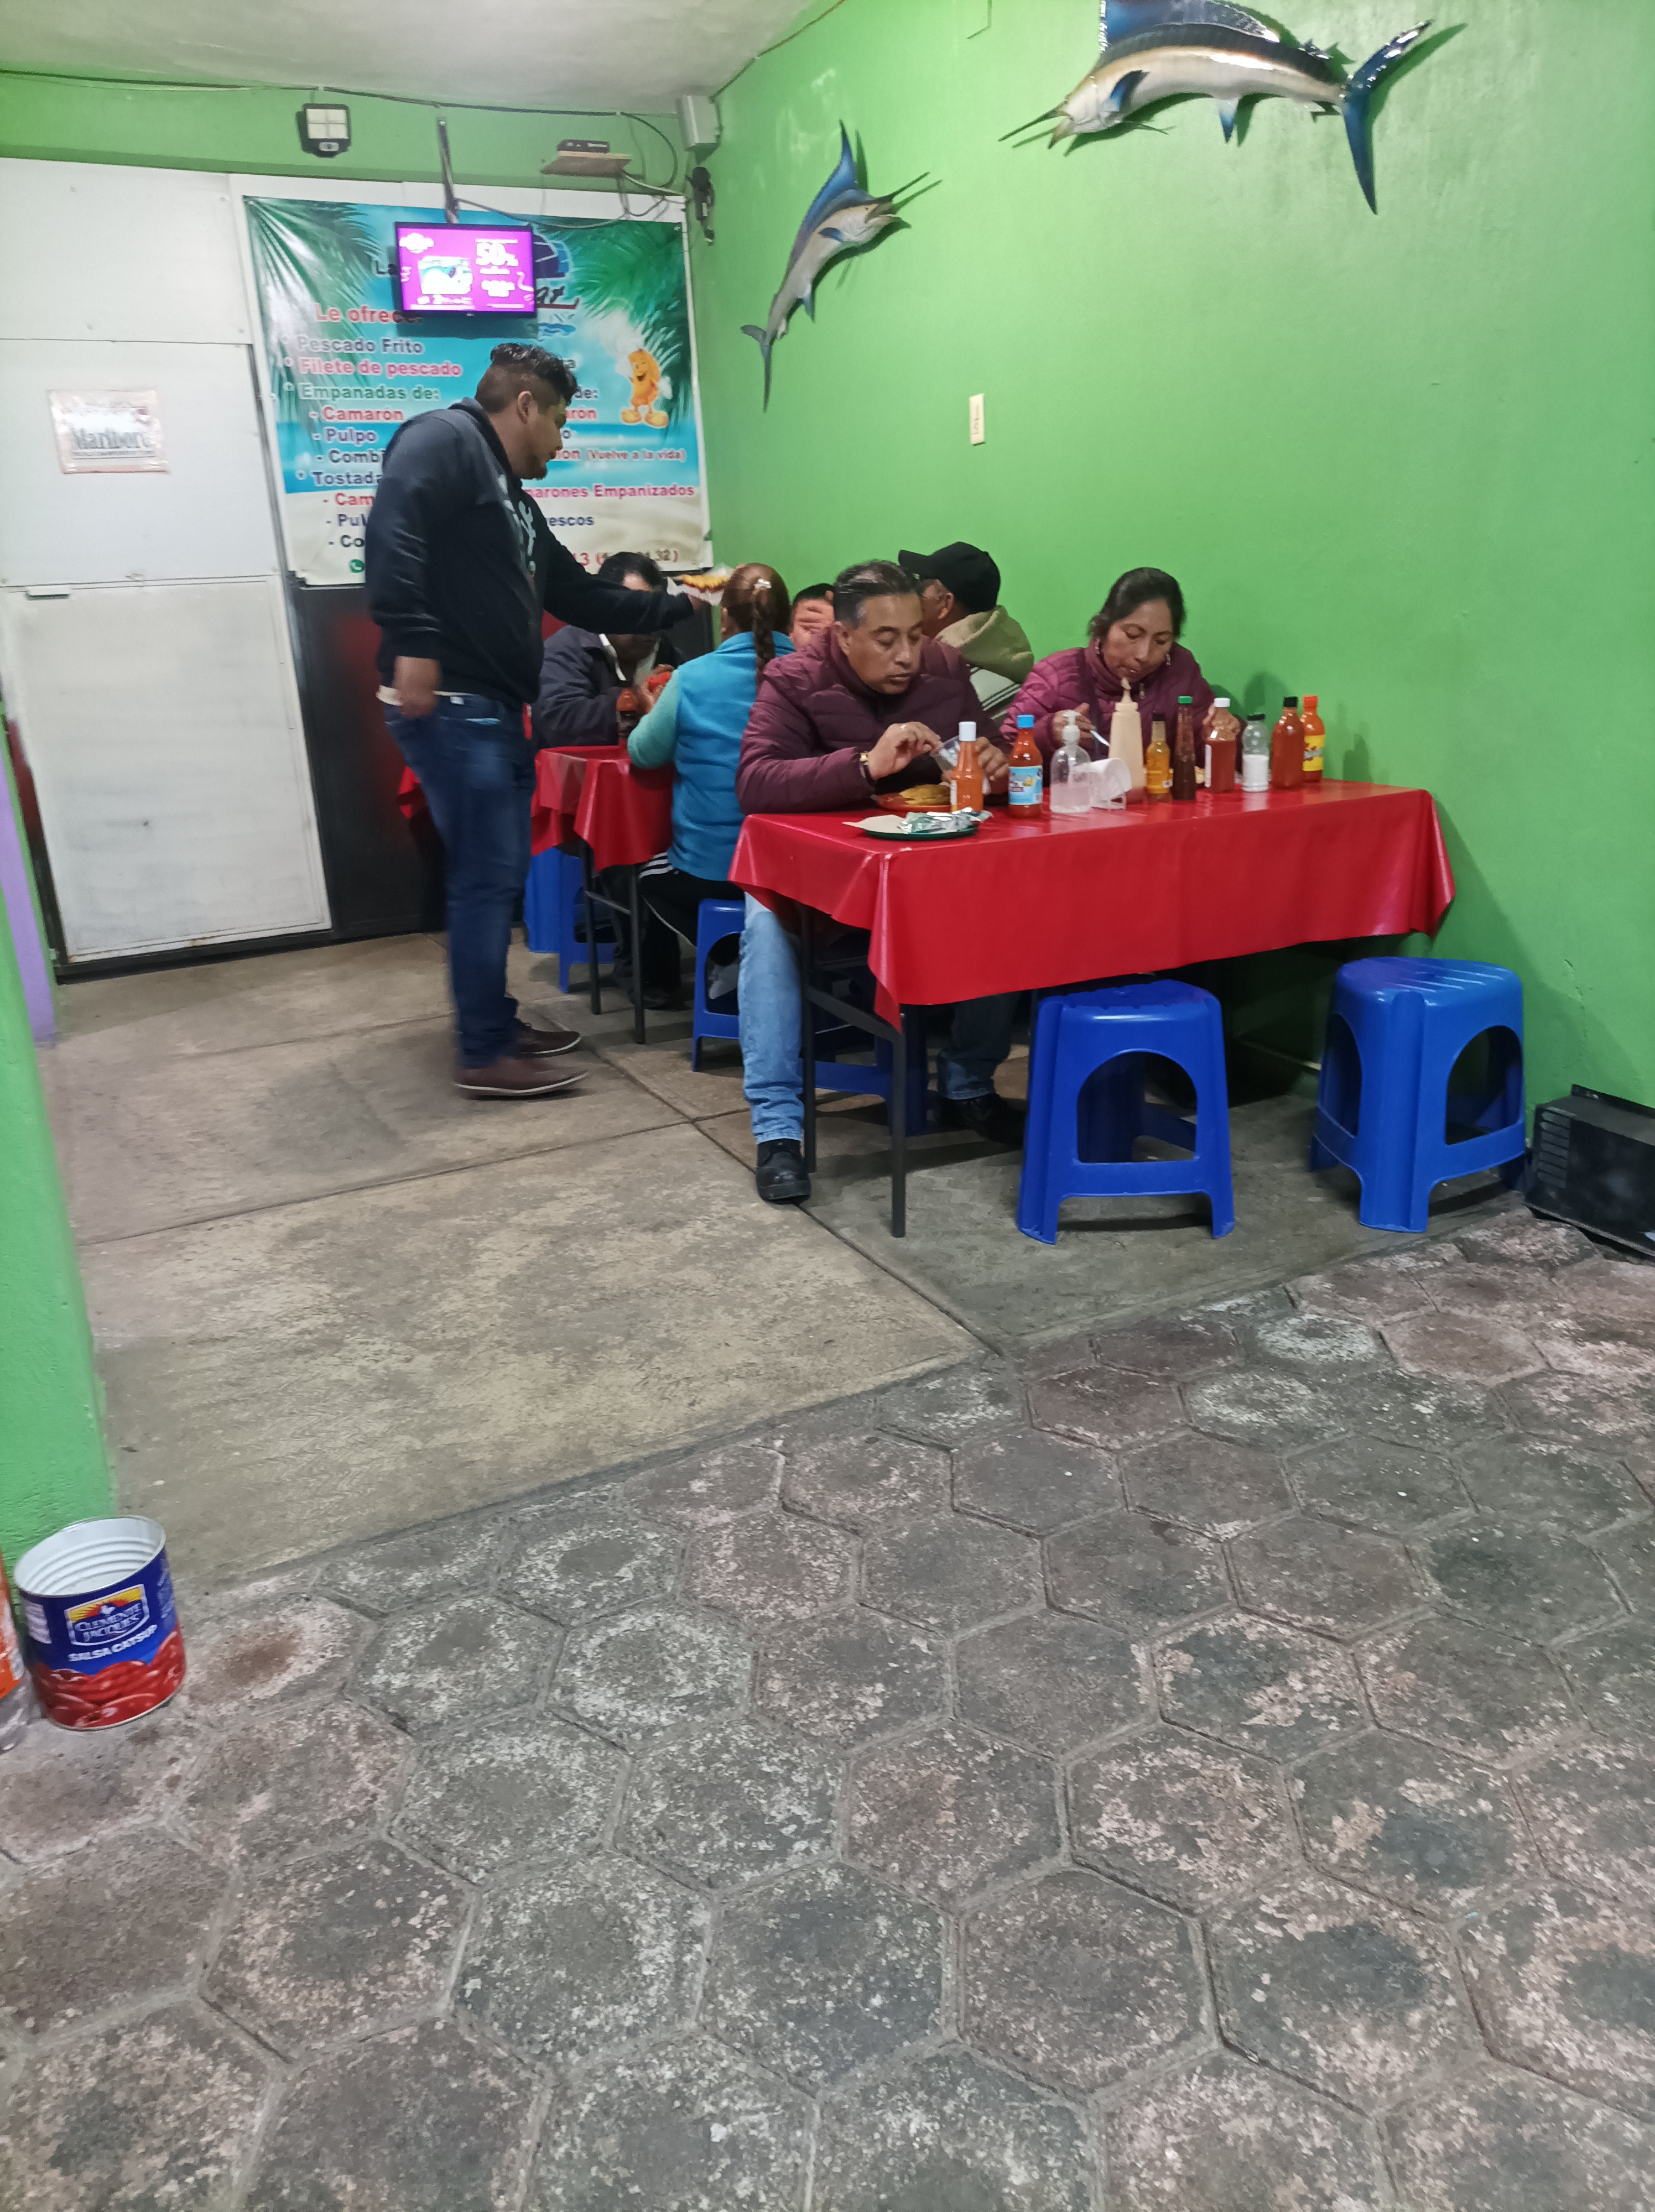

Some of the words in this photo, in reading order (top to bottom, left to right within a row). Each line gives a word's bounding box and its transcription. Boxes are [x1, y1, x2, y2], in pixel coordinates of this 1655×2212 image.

[315, 304, 342, 322] Le
[298, 336, 376, 353] Pescado
[382, 338, 424, 354] Frito
[300, 358, 354, 374] Filete
[360, 359, 382, 374] de
[387, 361, 462, 378] pescado
[303, 384, 407, 401] Empanadas
[412, 386, 440, 400] de:
[322, 406, 404, 421] Camarón
[325, 428, 377, 445] Pulpo
[632, 451, 639, 460] a
[643, 450, 653, 460] la
[335, 492, 374, 507] Cam
[594, 483, 695, 500] Empanizados
[337, 513, 368, 526] Pul
[545, 516, 595, 526] escos
